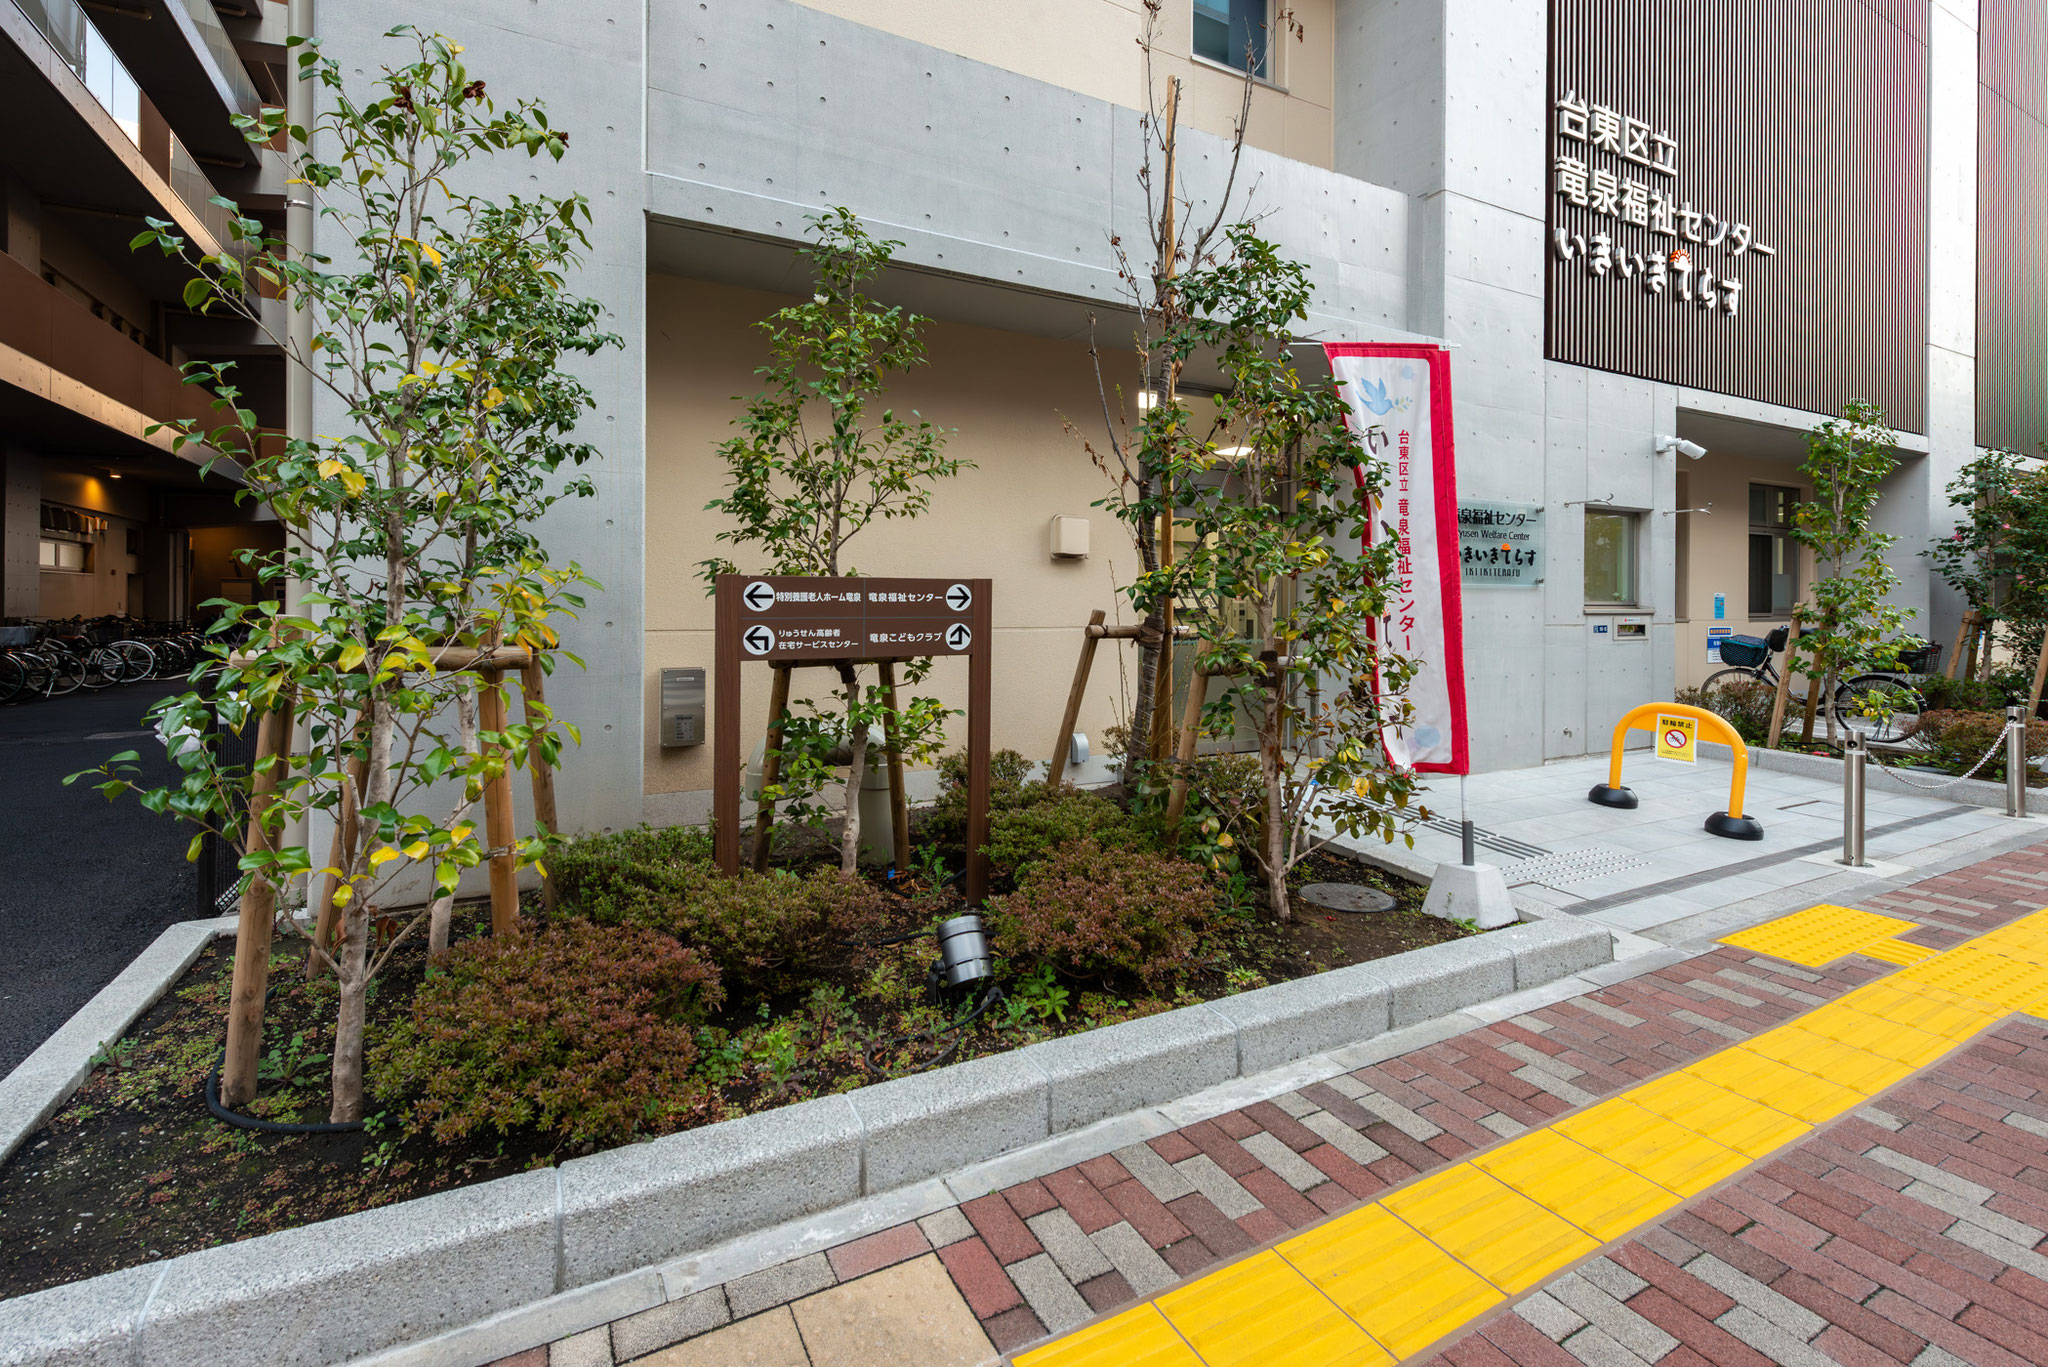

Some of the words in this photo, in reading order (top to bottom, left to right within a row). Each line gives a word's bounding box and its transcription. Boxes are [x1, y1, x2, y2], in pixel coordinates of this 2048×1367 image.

[1555, 90, 1678, 177] 台東区立
[1555, 153, 1775, 256] 竜泉福祉センター
[1554, 227, 1743, 316] いきいきてらす
[1398, 429, 1410, 492] 台東区立
[1458, 530, 1479, 540] yusen
[1481, 530, 1507, 540] Welfare
[1509, 531, 1530, 541] Center
[1459, 546, 1537, 567] きいきてらす
[868, 592, 943, 602] 竜泉福祉センター
[778, 628, 841, 638] りゅうせん高齢者
[869, 632, 943, 643] 竜泉こどもクラブ
[778, 640, 859, 650] 在宅サービスセンター
